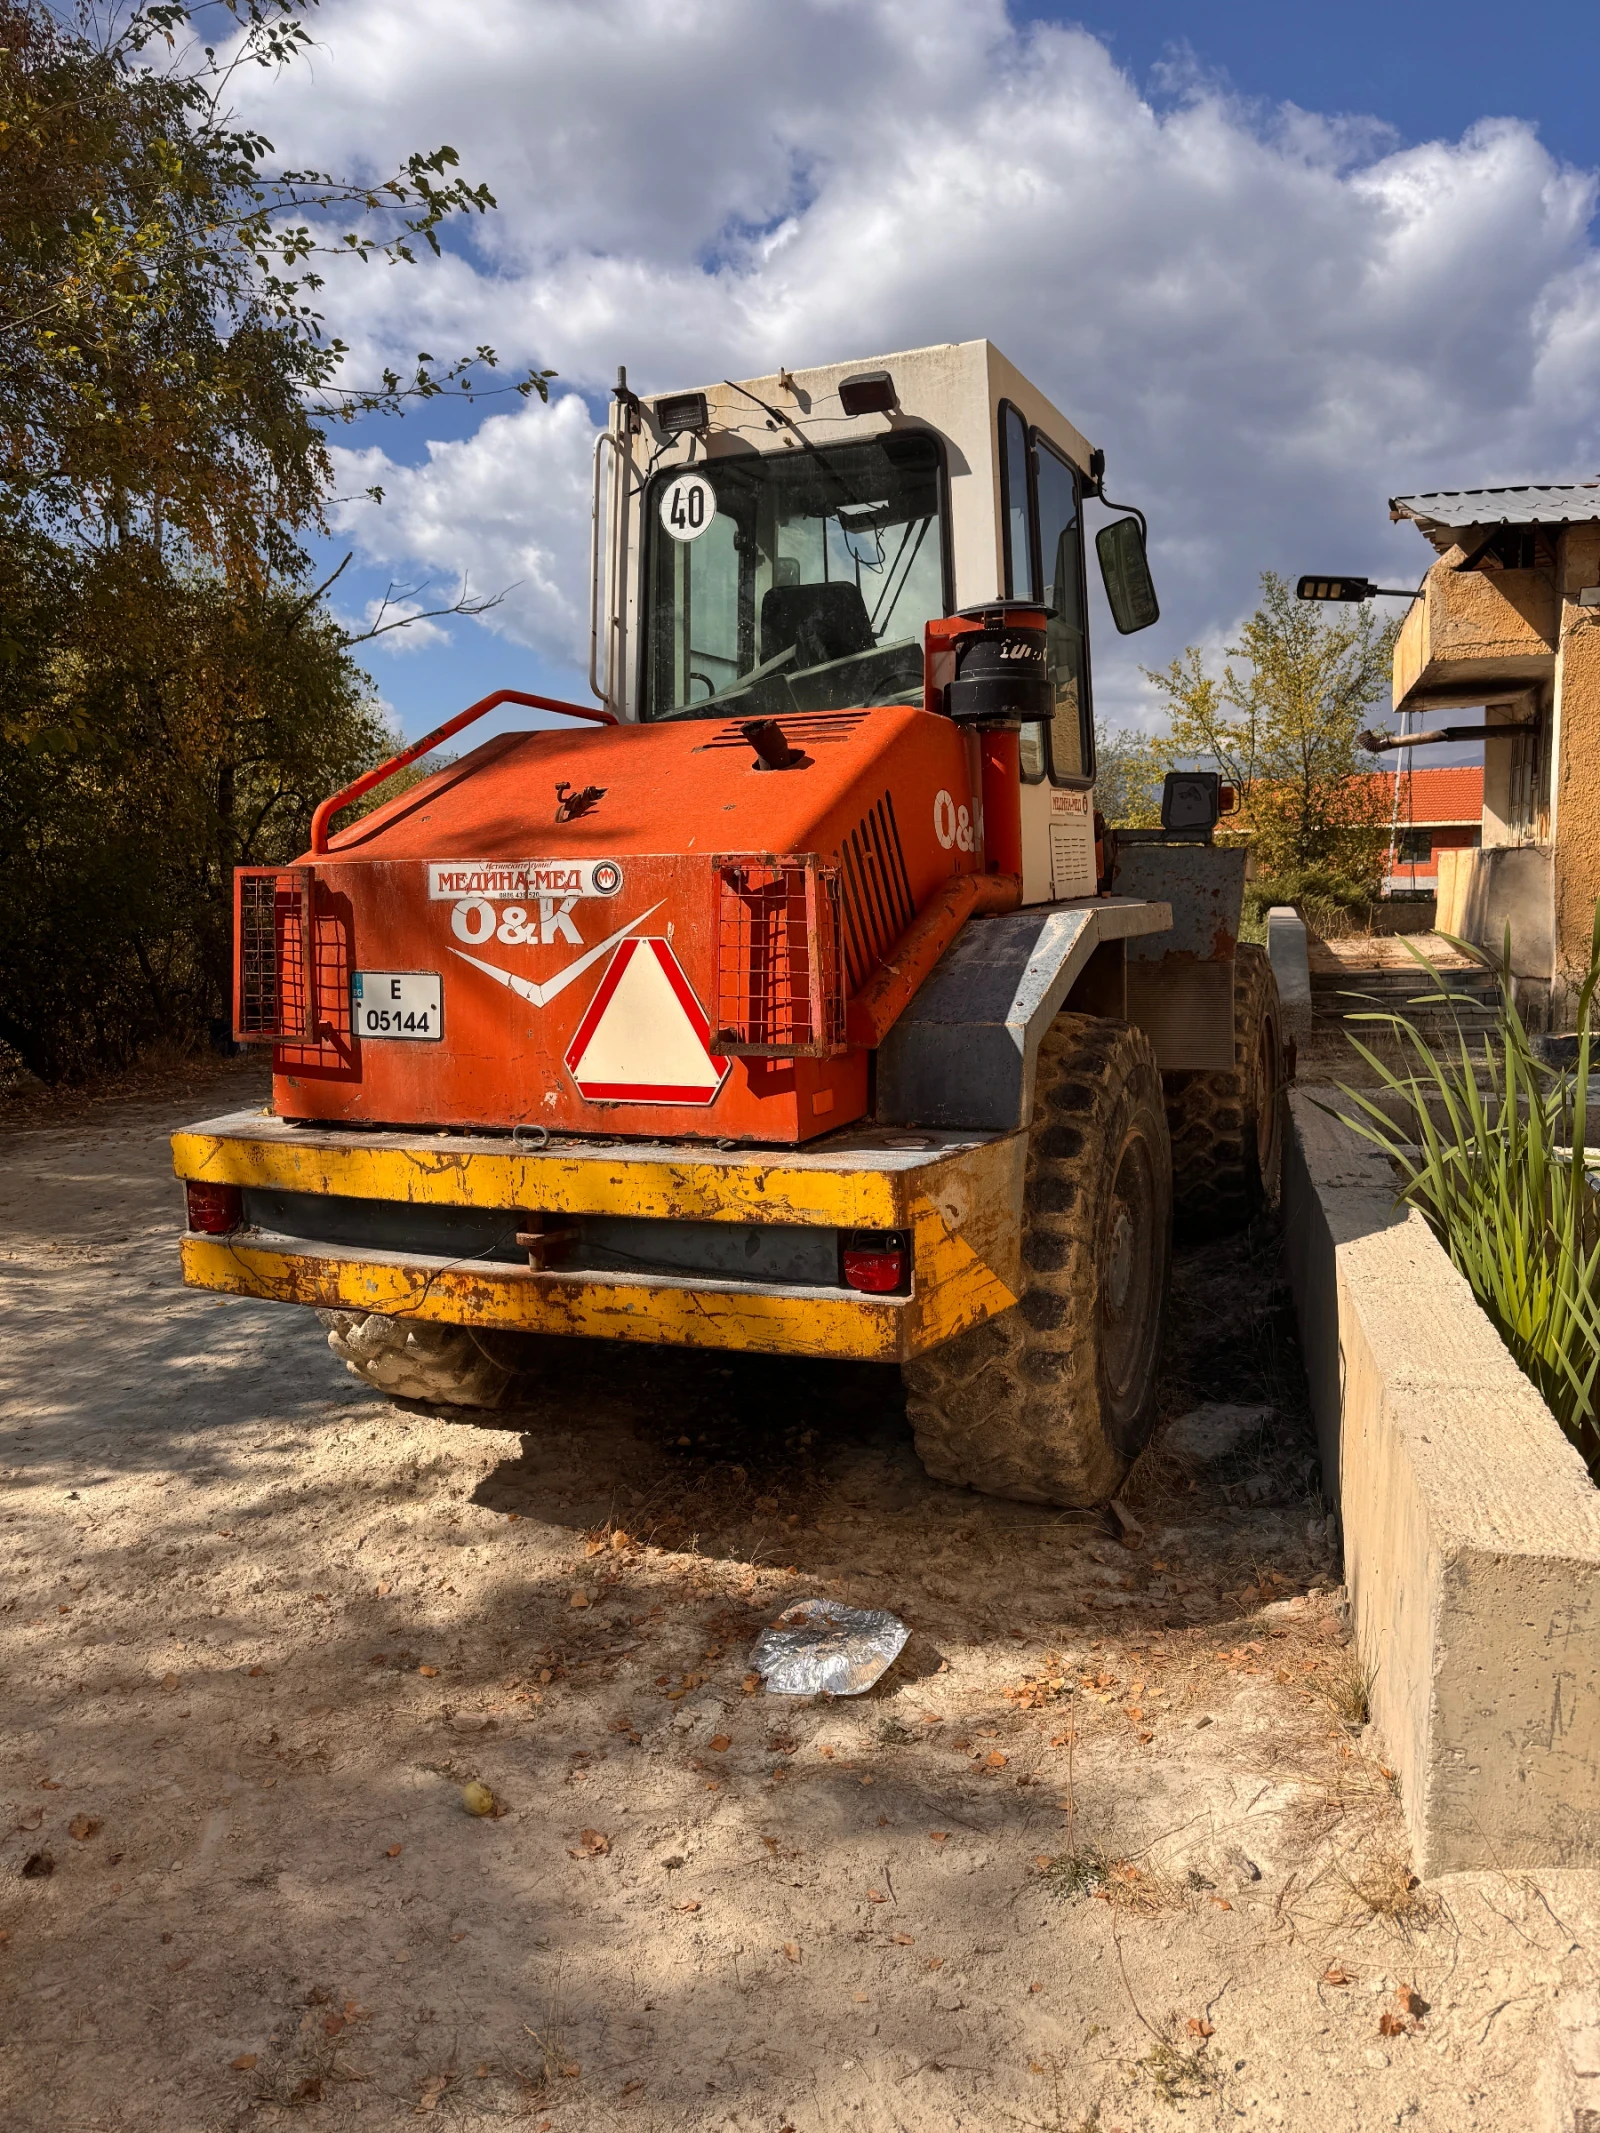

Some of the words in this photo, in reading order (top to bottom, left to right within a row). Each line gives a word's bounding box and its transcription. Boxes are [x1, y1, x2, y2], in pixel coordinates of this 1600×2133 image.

[670, 485, 705, 530] 40
[438, 869, 584, 895] МЕДИНА-МЕД
[451, 897, 584, 945] O&K
[390, 979, 401, 1000] E
[366, 1009, 430, 1032] 05144
